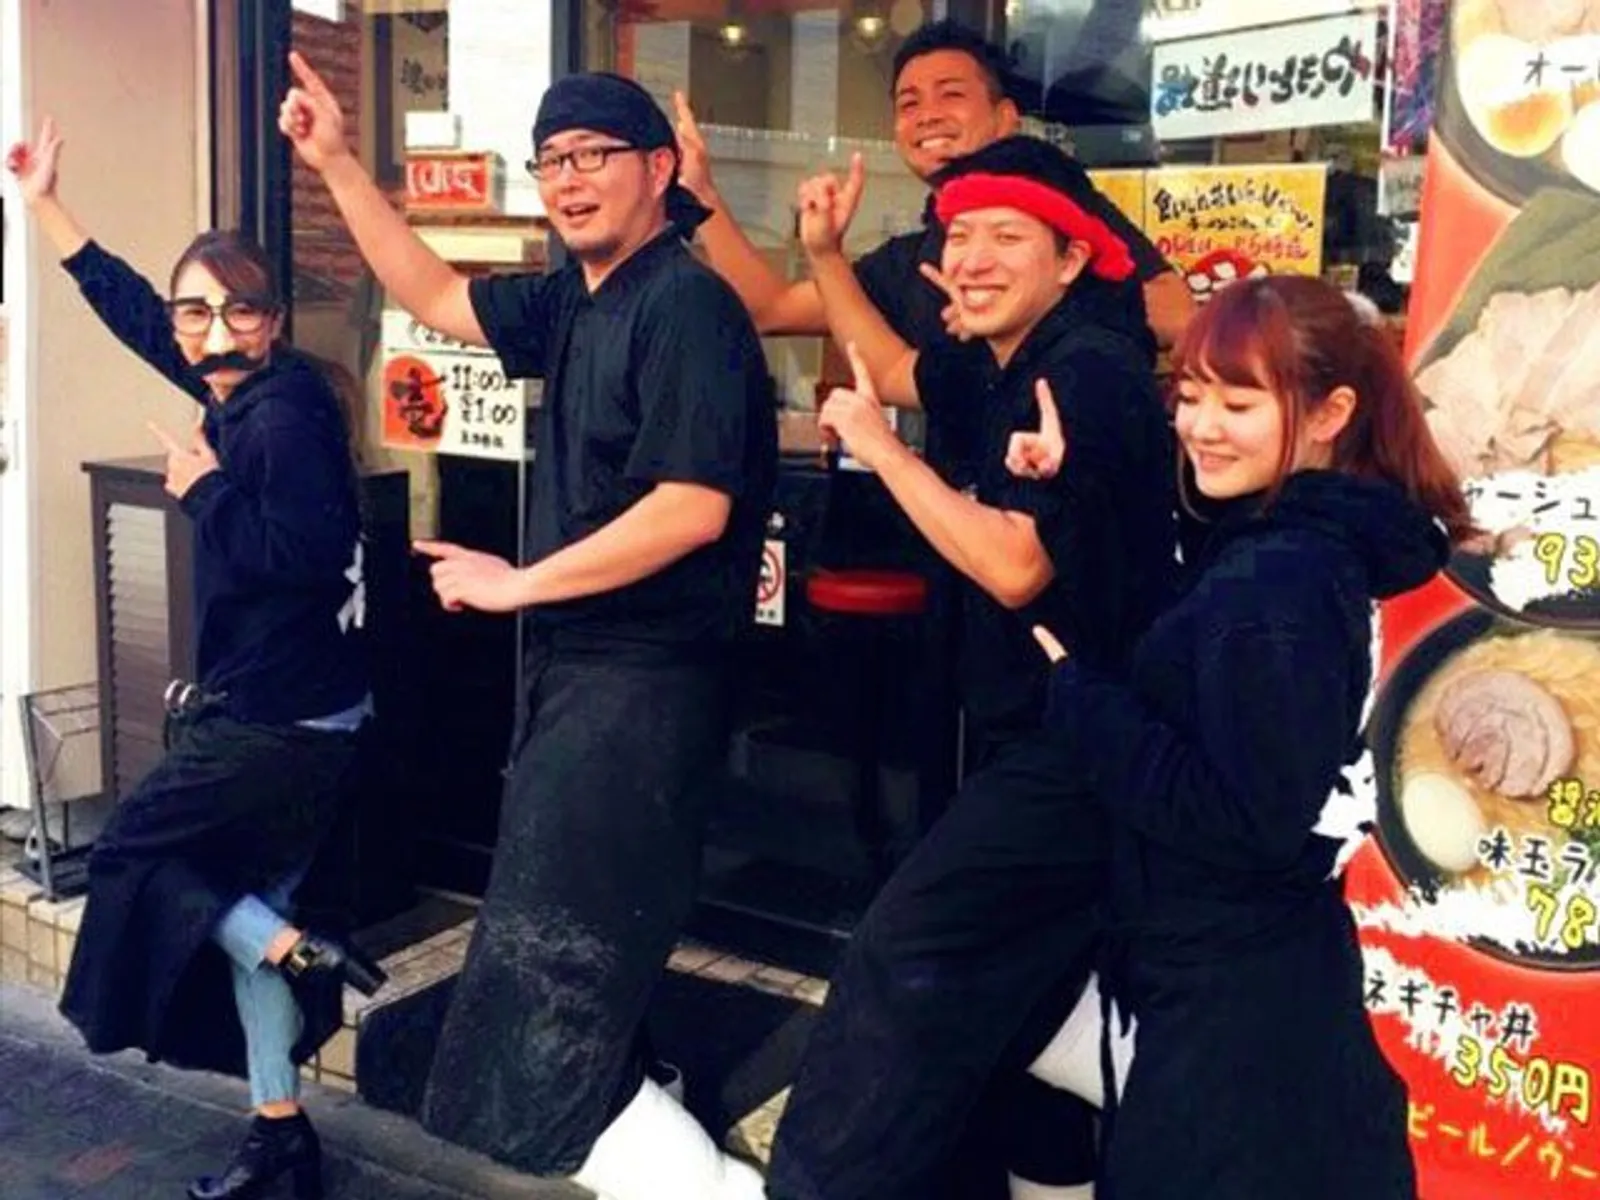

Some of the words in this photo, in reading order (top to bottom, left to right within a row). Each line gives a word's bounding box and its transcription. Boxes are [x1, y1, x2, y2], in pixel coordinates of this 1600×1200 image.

[1523, 51, 1600, 88] オー
[1478, 829, 1597, 885] 味玉ラ
[1365, 970, 1534, 1049] ネギチャ丼
[1452, 1034, 1590, 1127] 350円
